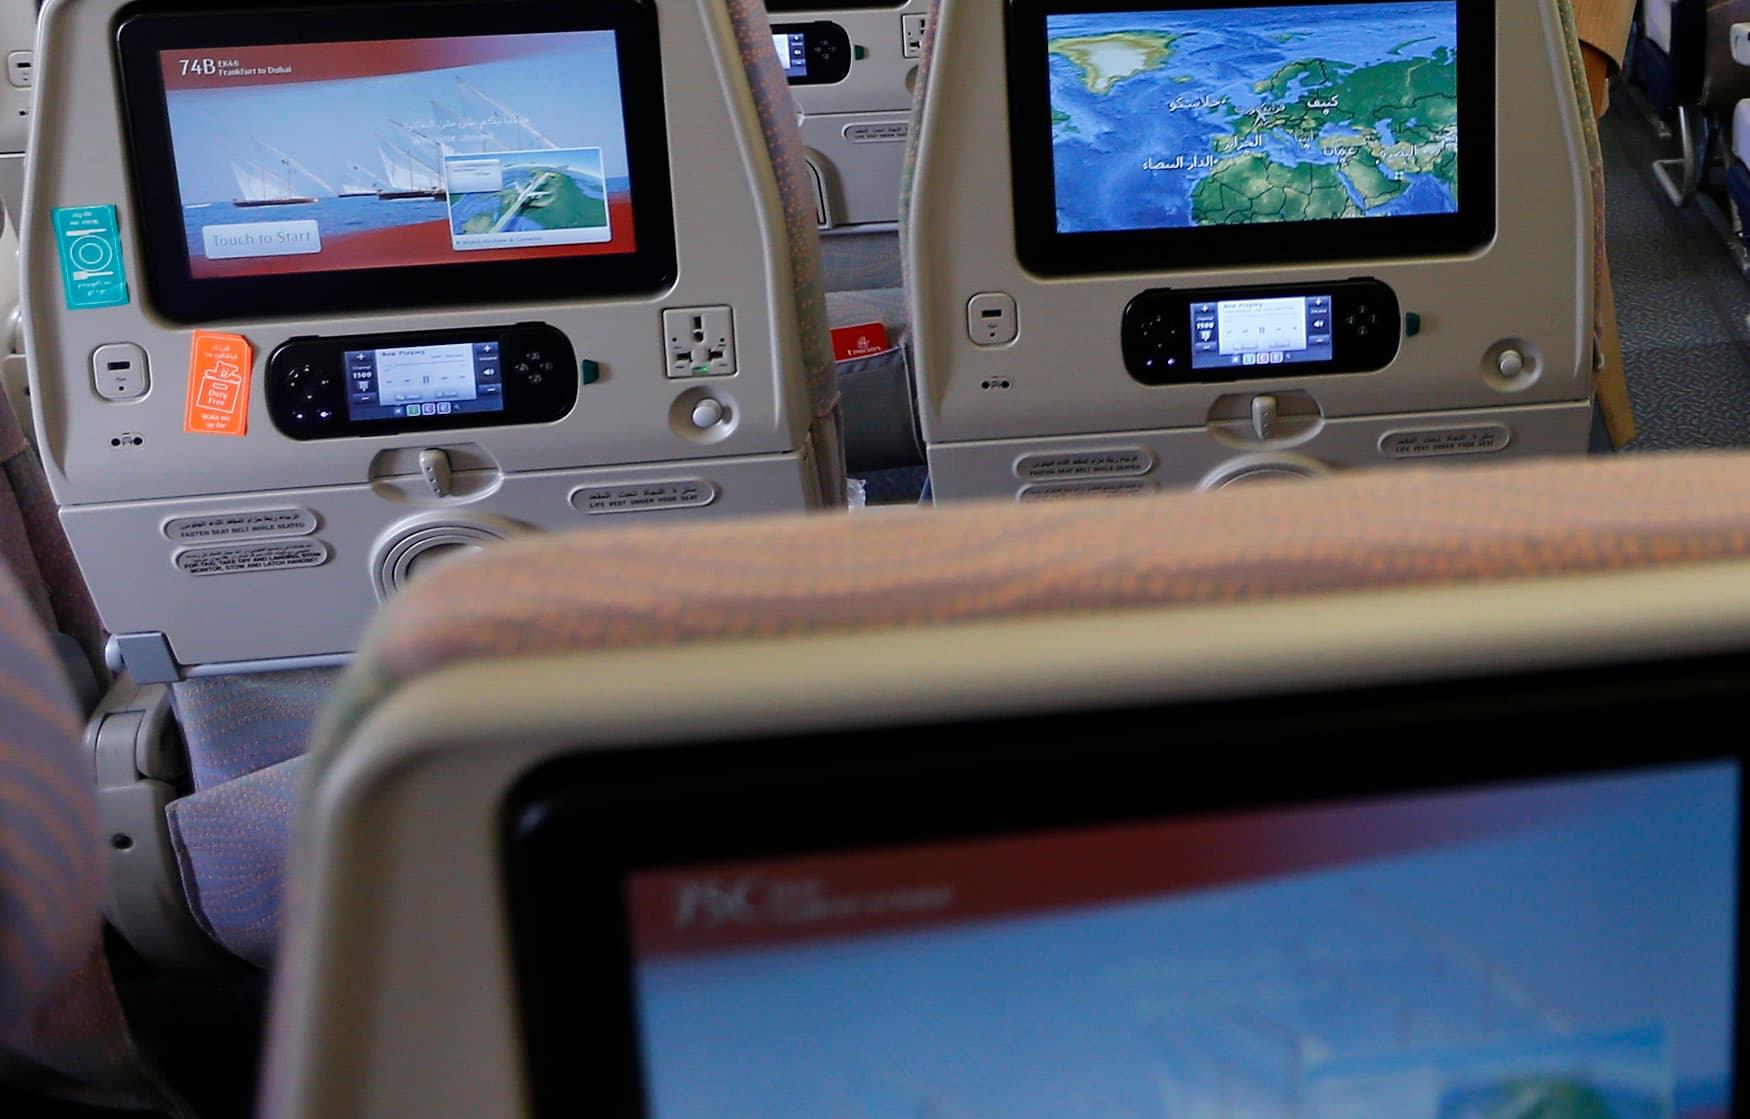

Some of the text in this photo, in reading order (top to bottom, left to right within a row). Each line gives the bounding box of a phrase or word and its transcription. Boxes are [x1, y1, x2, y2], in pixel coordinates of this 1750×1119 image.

[179, 58, 216, 76] 74B
[214, 231, 311, 247] Touch to Start
[208, 389, 229, 400] Duty
[180, 529, 210, 538] FASTEN
[211, 528, 230, 536] SEAT
[231, 526, 249, 534] BELT
